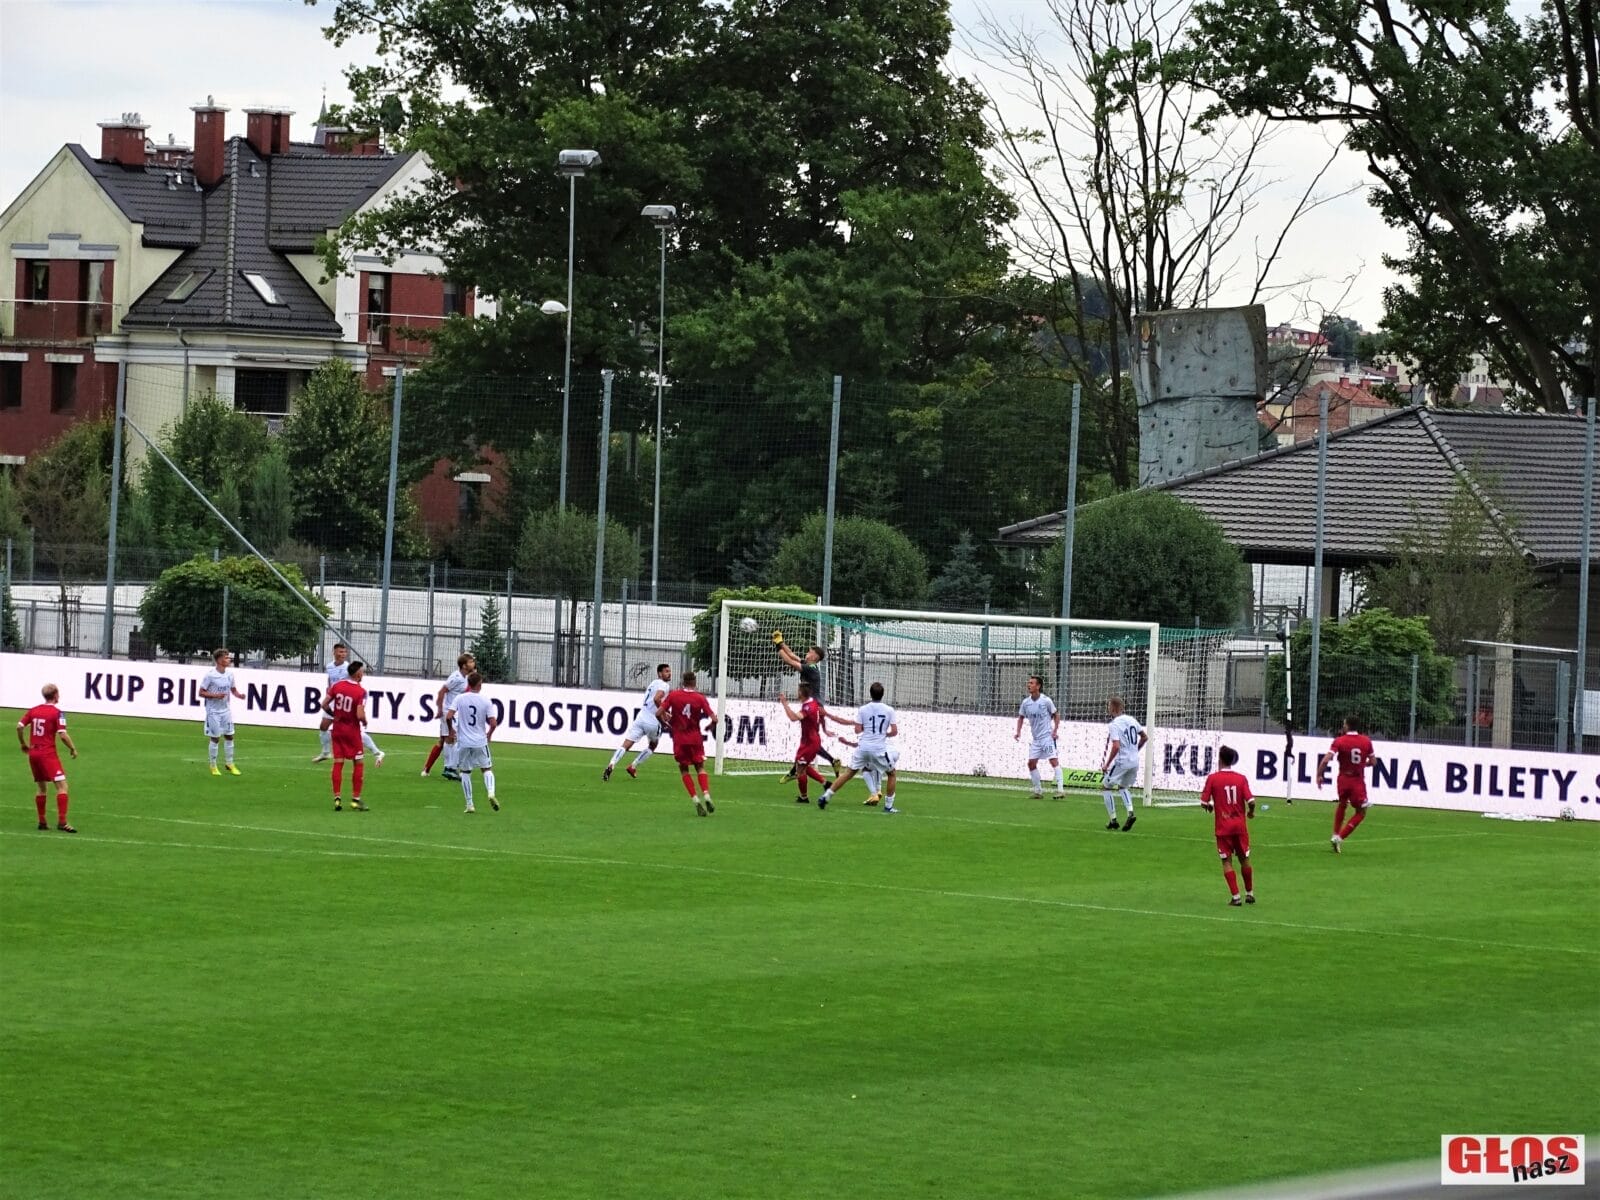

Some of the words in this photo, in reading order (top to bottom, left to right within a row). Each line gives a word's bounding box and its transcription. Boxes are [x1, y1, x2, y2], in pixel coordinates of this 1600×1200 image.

[85, 672, 144, 702] KUP
[158, 677, 206, 707] BIL
[247, 682, 291, 713] NA
[336, 693, 353, 713] 30
[682, 703, 692, 719] 4
[468, 705, 477, 727] 3
[869, 715, 886, 734] 17
[32, 718, 46, 737] 15
[1124, 725, 1138, 746] 10
[1350, 748, 1362, 765] 6
[1256, 749, 1333, 785] BILE
[1372, 757, 1428, 791] NA
[1445, 762, 1600, 804] BILETY.
[1223, 785, 1238, 805] 11
